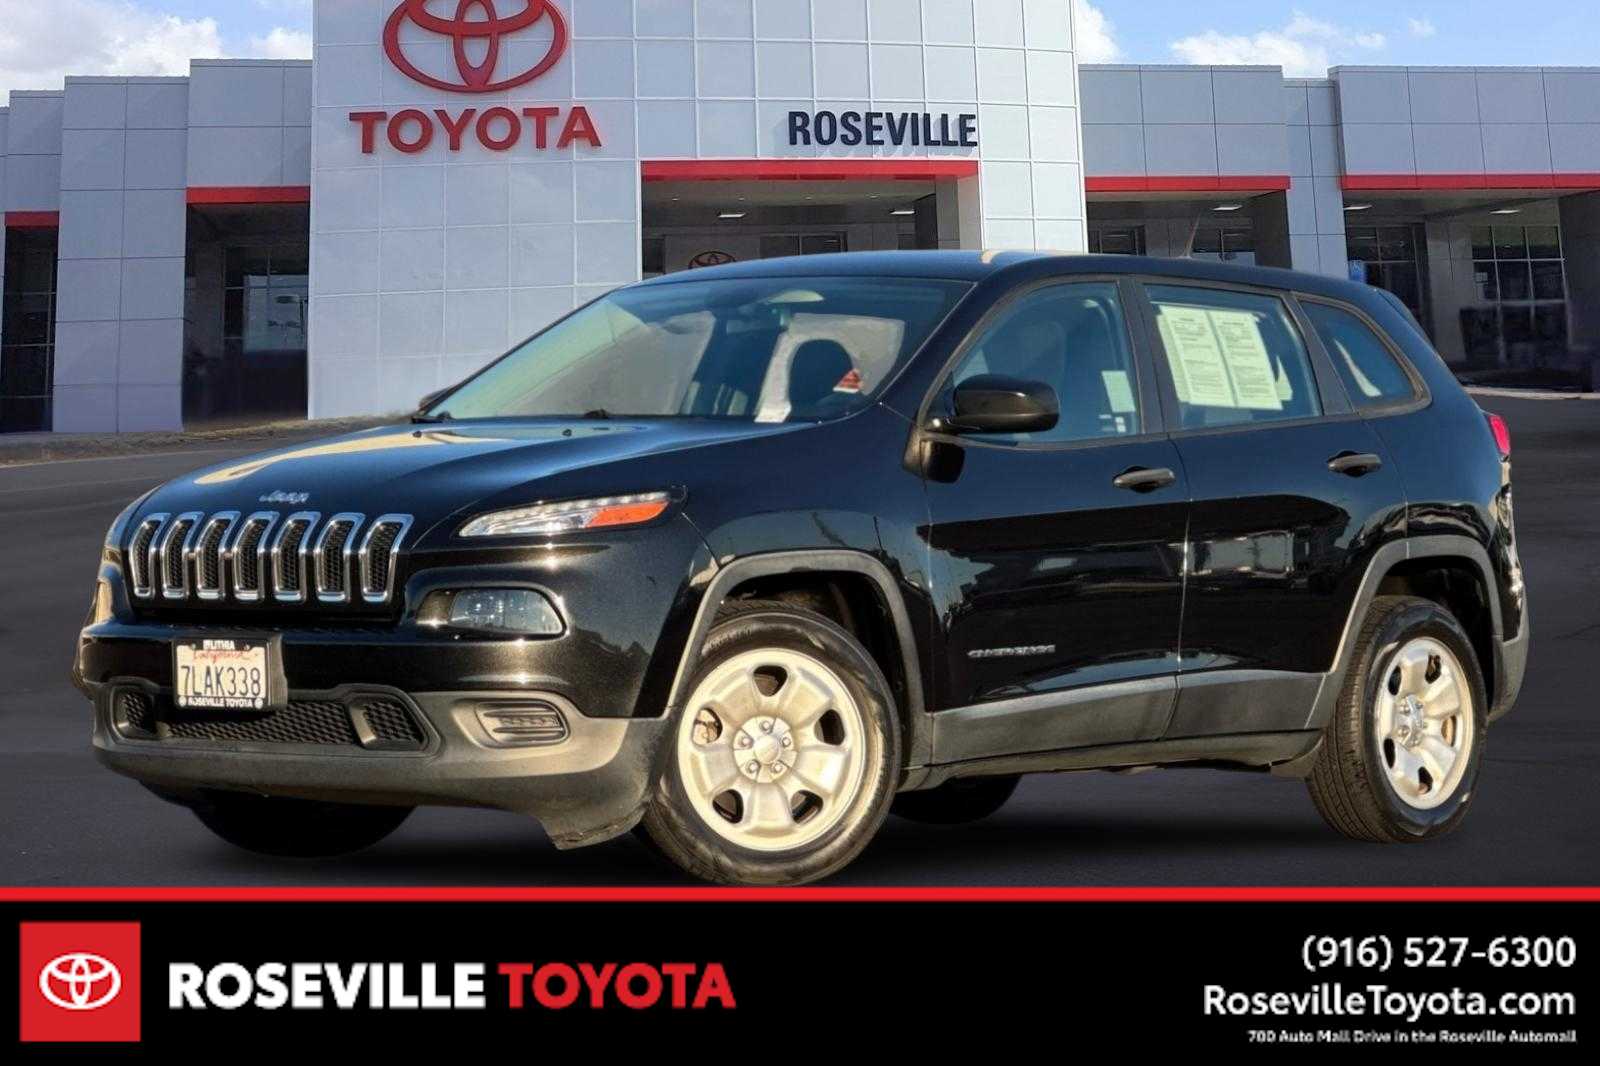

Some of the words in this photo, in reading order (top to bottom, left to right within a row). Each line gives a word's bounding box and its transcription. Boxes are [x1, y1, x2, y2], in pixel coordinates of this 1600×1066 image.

[349, 106, 602, 154] TOYOTA
[788, 110, 978, 147] ROSEVILLE
[180, 665, 261, 697] 7LAK338
[187, 697, 225, 707] ROSEVILLE
[225, 698, 253, 708] TOYOTA
